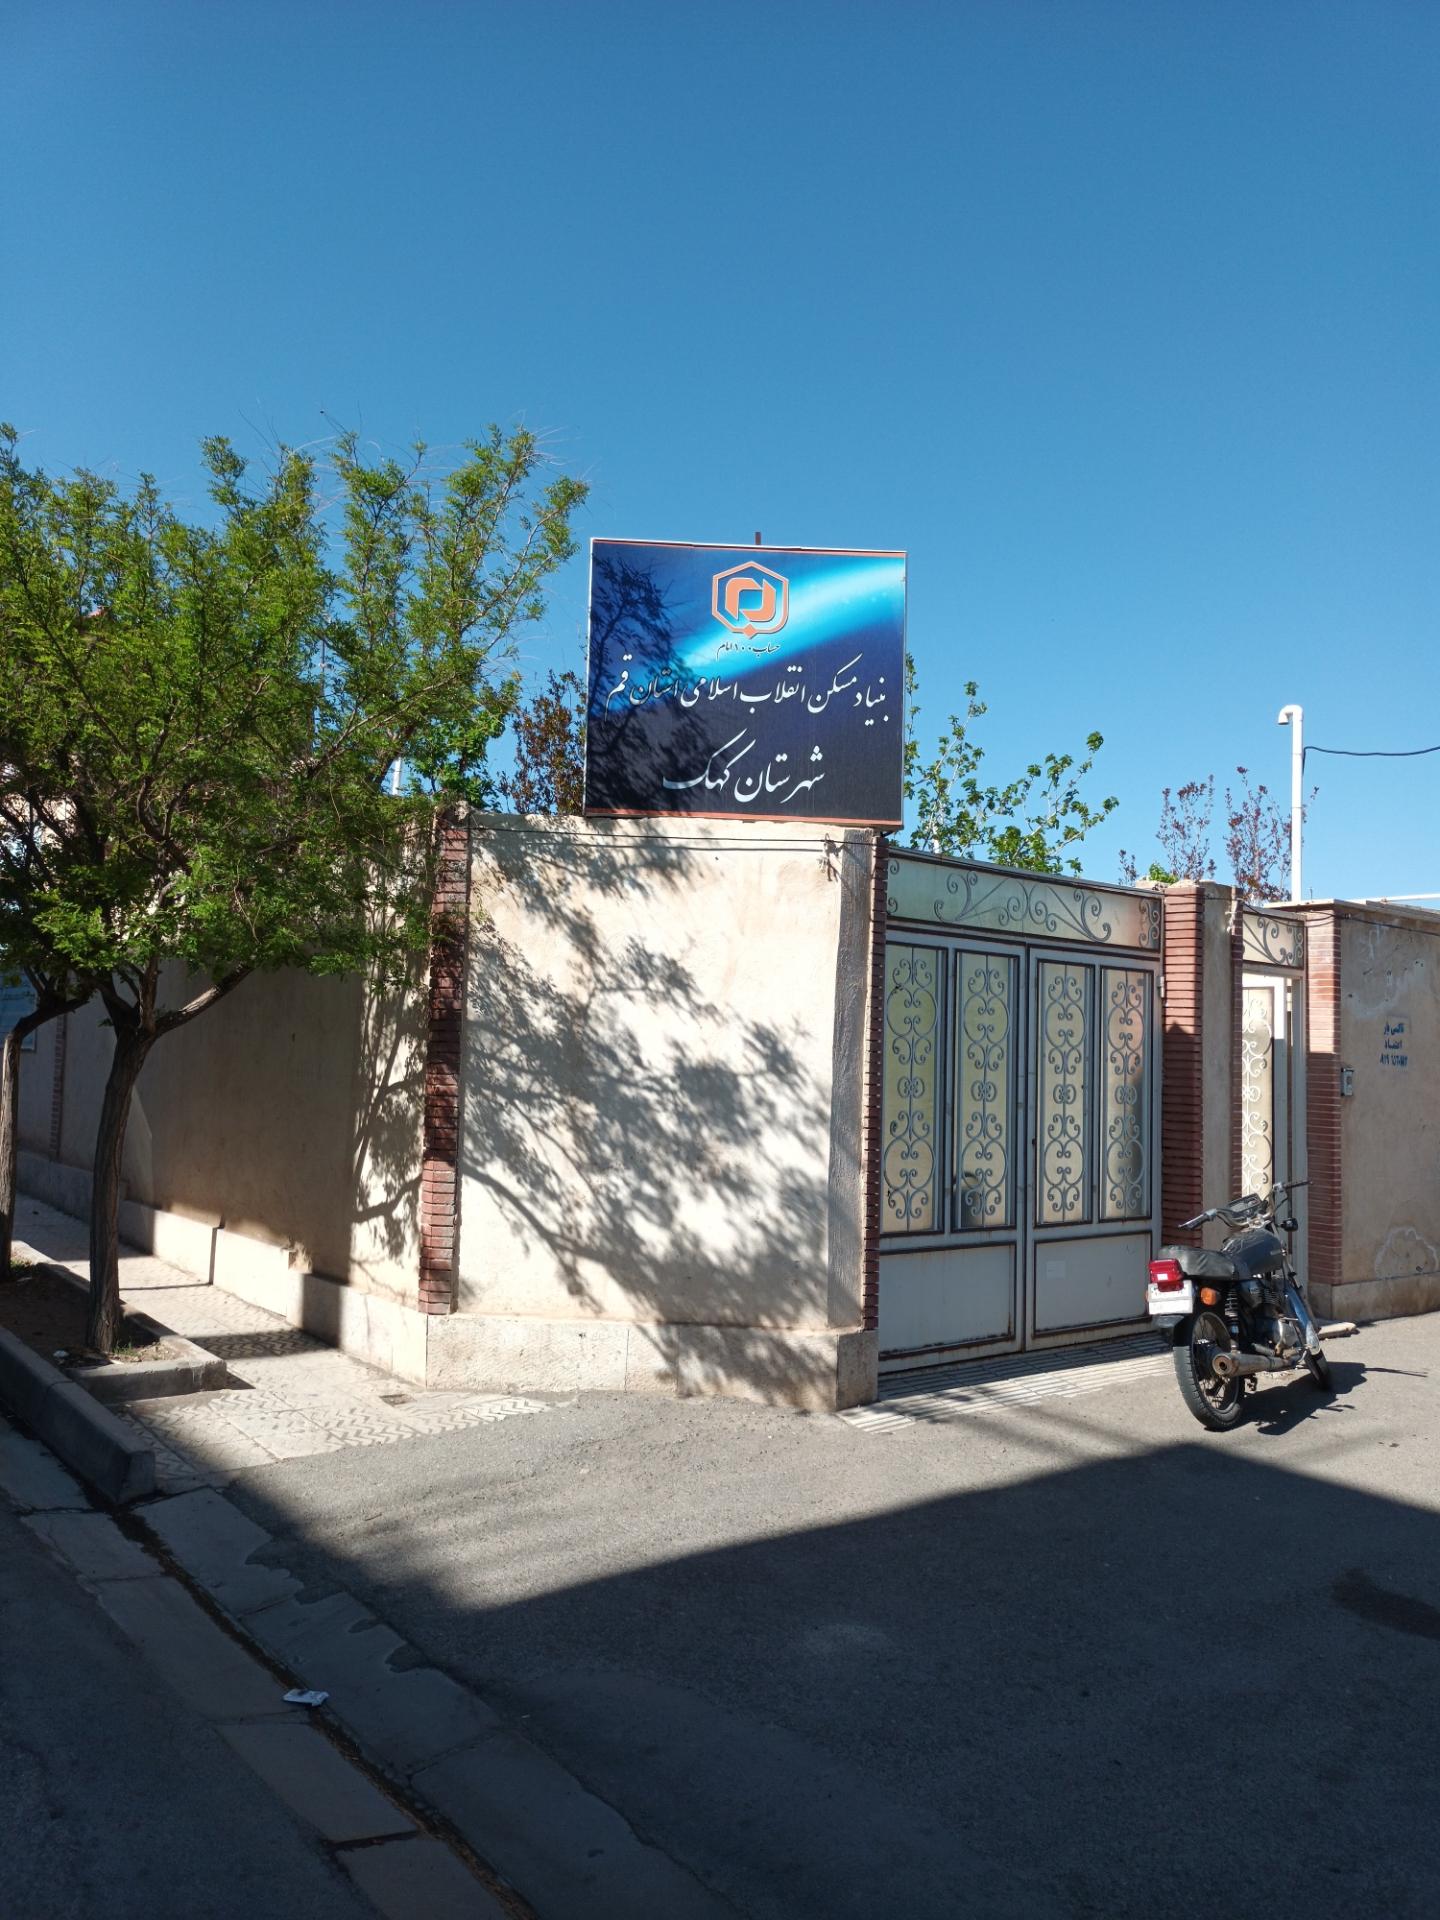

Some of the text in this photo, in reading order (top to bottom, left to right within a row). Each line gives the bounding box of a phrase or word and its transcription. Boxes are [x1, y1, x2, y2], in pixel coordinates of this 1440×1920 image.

[716, 641, 781, 662] حساب ۱۰۰ امام
[604, 652, 889, 726] بنیاد مسکن انقلاب اسلامی استان قم
[662, 727, 826, 804] شهرستان کهک
